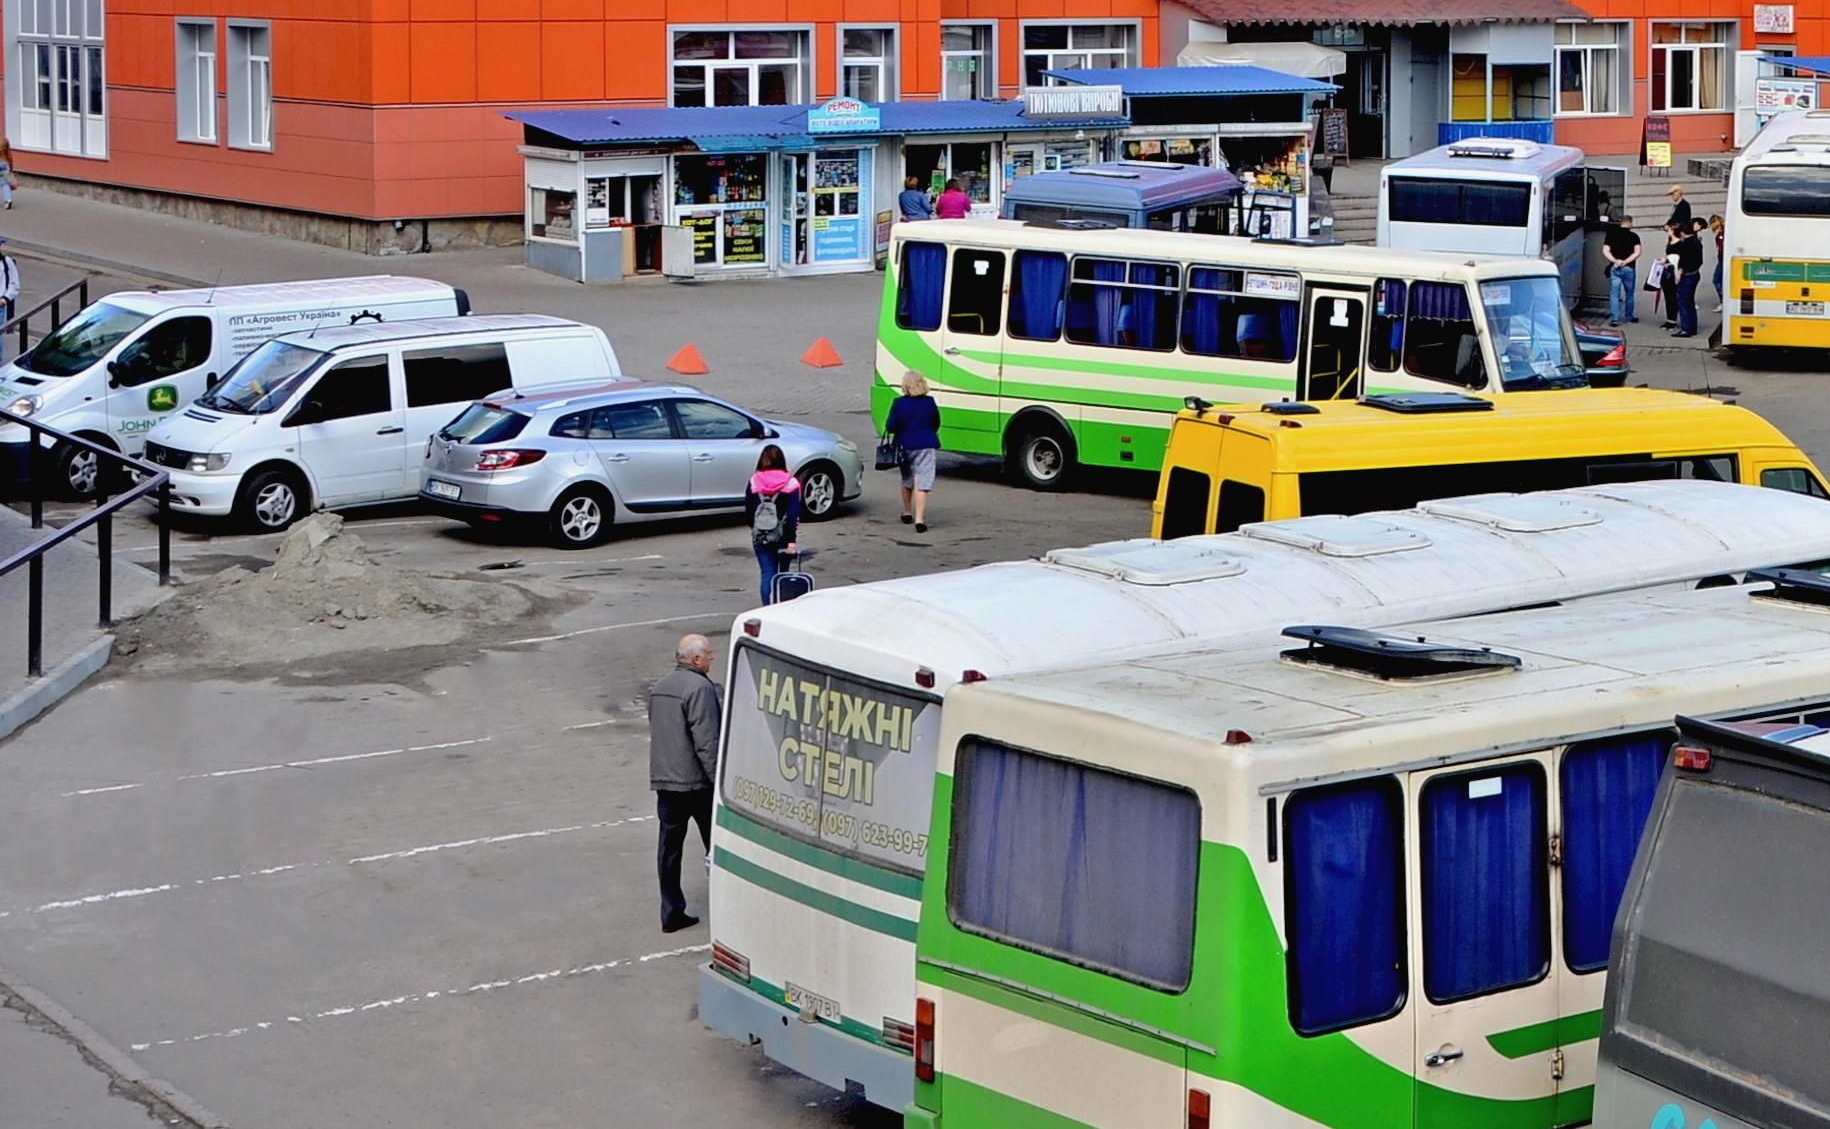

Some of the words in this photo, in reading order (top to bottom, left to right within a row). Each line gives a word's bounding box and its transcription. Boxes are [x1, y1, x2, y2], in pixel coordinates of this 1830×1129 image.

[827, 100, 861, 113] РЕМОНТ
[1029, 92, 1080, 114] ТЮТЮНОВІ
[1081, 91, 1119, 112] ВИРОБИ
[757, 668, 913, 753] НАТЯЖНІ
[778, 737, 875, 806] СТЕЛІ
[861, 818, 929, 858] 623-99-7
